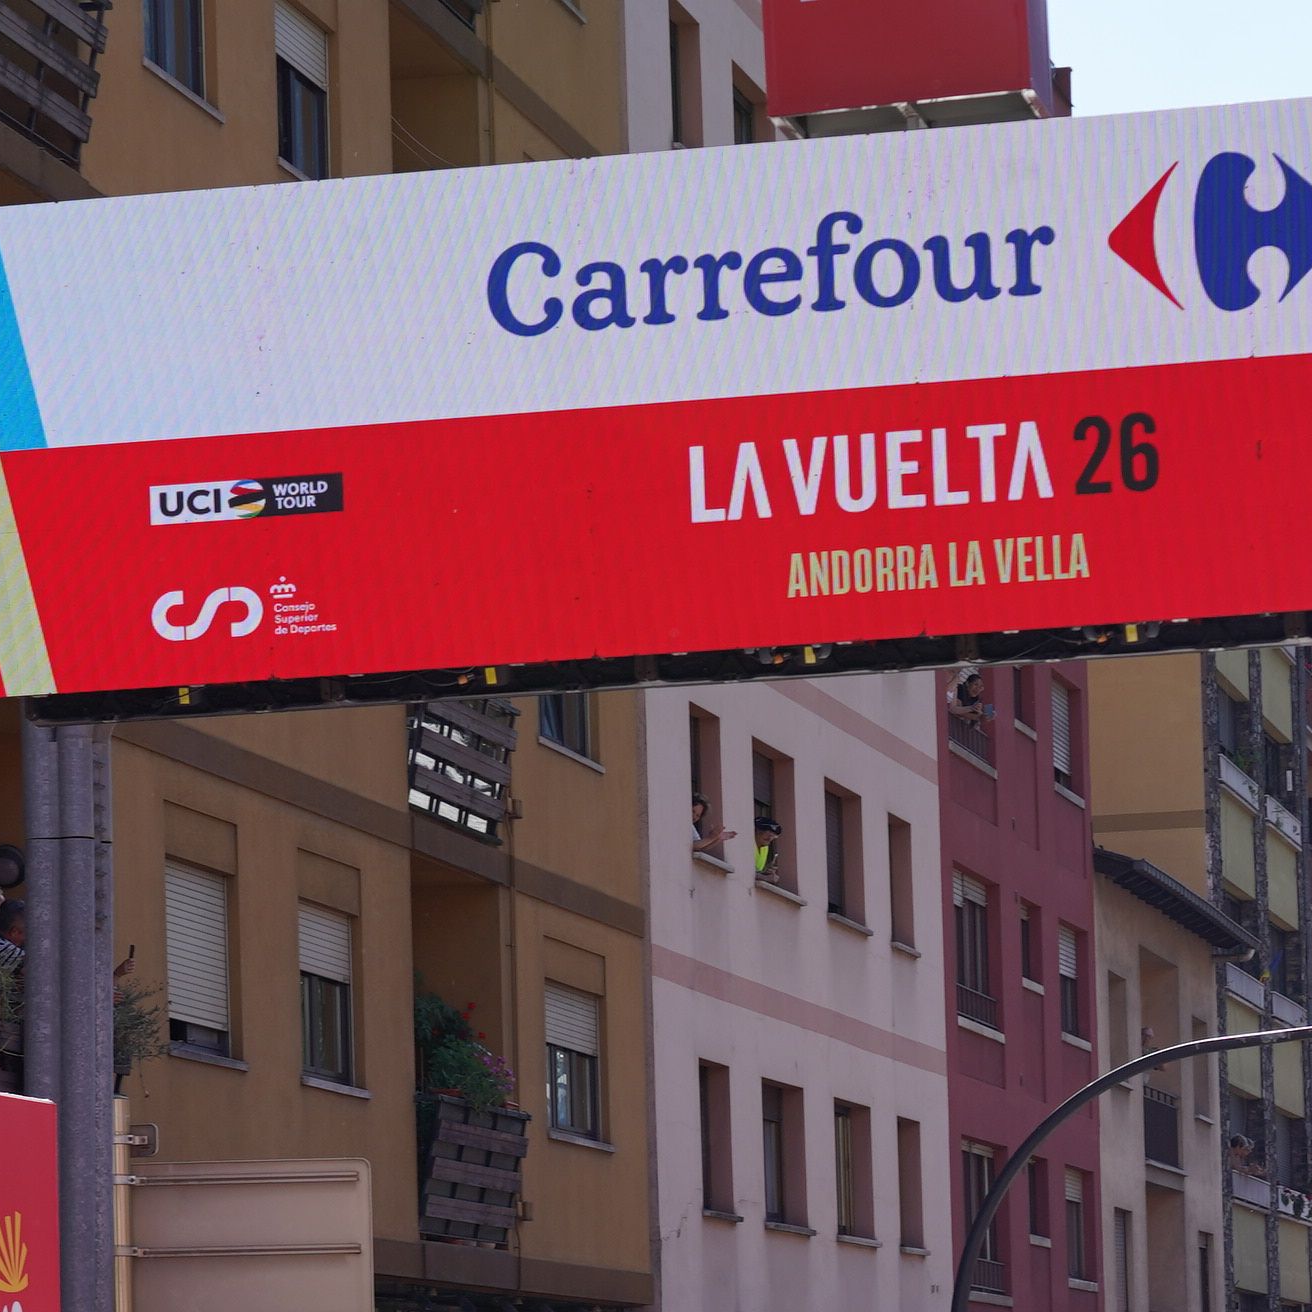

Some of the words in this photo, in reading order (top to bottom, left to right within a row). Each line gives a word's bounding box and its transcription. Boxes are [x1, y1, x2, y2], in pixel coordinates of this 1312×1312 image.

[487, 211, 1056, 337] Carrefour
[689, 441, 773, 524] LA
[782, 420, 1055, 516] VUELTA
[1072, 412, 1159, 496] 26
[272, 479, 328, 497] WORLD
[159, 488, 221, 517] UCI
[274, 495, 317, 509] TOUR
[787, 540, 938, 599] ANDORRA
[947, 537, 986, 589] LA
[993, 533, 1090, 584] VELLA
[273, 601, 316, 614] Consejo
[275, 612, 319, 625] Superior
[275, 625, 288, 635] de
[290, 622, 337, 635] Deportes
